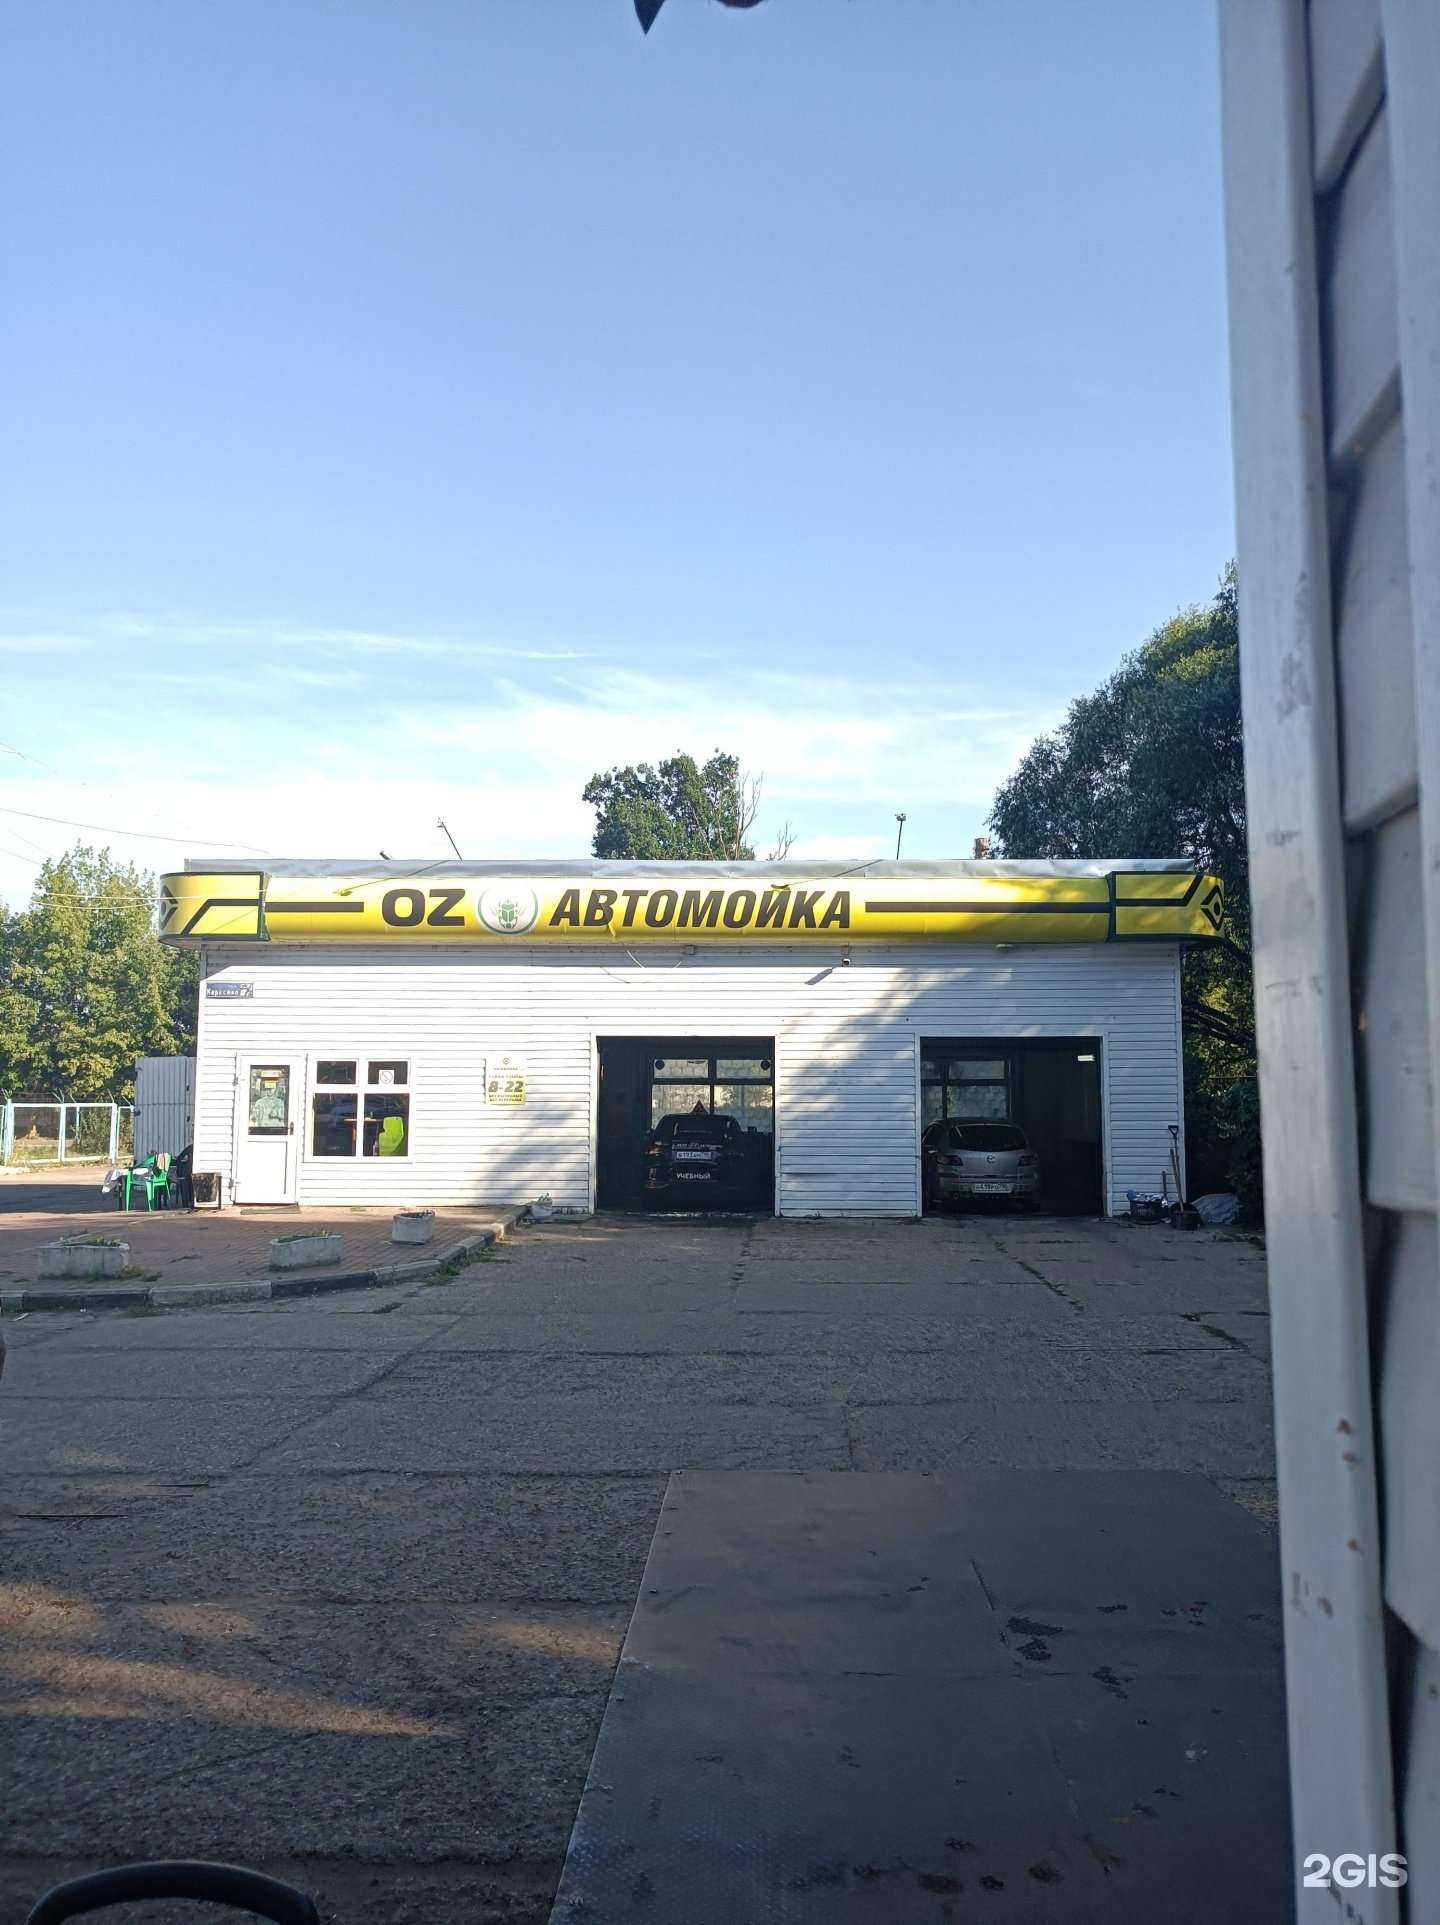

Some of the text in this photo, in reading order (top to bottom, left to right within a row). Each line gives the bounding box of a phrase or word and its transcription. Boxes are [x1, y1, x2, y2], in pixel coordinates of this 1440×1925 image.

[381, 888, 466, 927] OZ
[549, 885, 850, 929] АВТОМОЙКА
[488, 1080, 524, 1093] 8-22
[676, 1172, 711, 1180] УЧЕБНЫЙ
